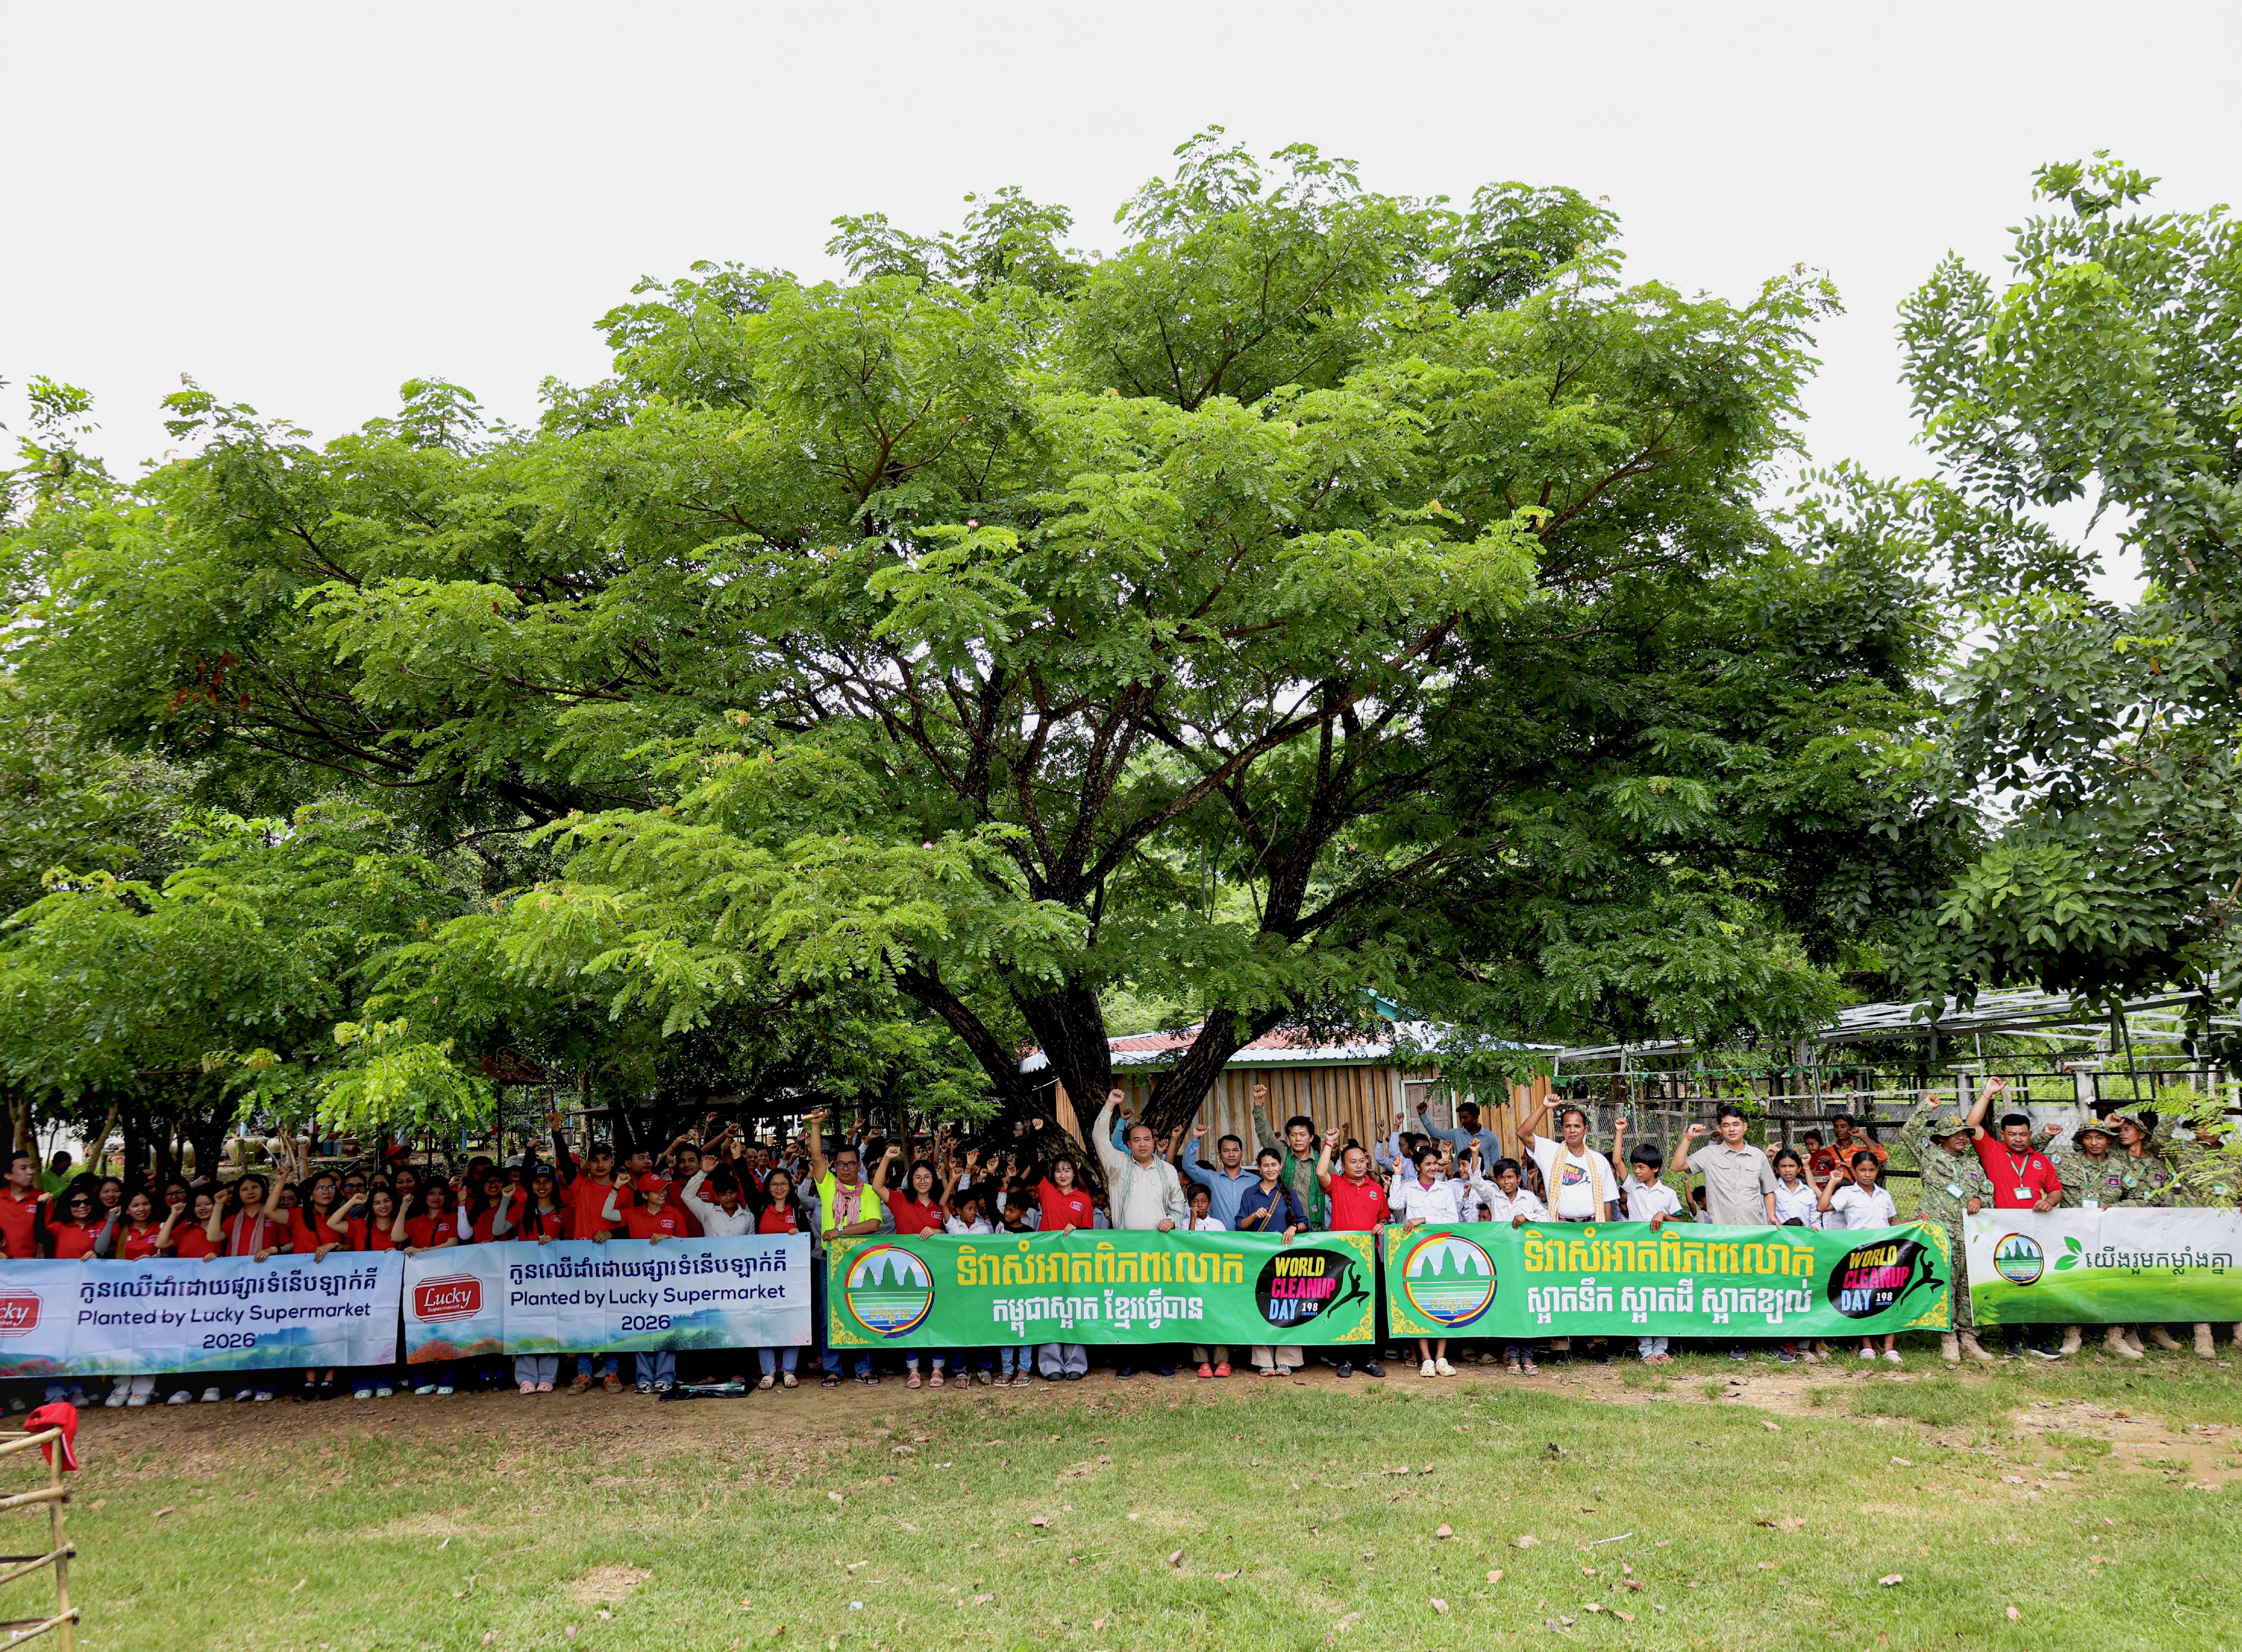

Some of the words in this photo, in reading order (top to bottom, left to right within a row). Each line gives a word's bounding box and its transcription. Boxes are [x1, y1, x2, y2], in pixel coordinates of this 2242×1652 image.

[1563, 1170, 1582, 1180] LEANUP
[1276, 1257, 1324, 1276] WORLD
[1850, 1246, 1896, 1268] WORLD
[1271, 1278, 1336, 1298] CLEANUP
[1844, 1267, 1909, 1288] CLEANUP
[423, 1286, 472, 1309] Lucky
[511, 1290, 579, 1306] Planted
[585, 1290, 605, 1307] by
[610, 1289, 658, 1307] Lucky
[664, 1284, 785, 1305] Supermarket
[1840, 1289, 1871, 1311] DAY
[1876, 1292, 1892, 1301] 198
[0, 1302, 30, 1326] cky
[78, 1310, 156, 1325] Planted
[162, 1310, 186, 1326] by
[191, 1307, 244, 1325] Lucky
[250, 1303, 370, 1323] Supermarket
[427, 1304, 460, 1313] Supermarket
[1269, 1299, 1298, 1321] DAY
[1302, 1303, 1317, 1311] 198
[622, 1315, 670, 1330] 2026
[203, 1333, 256, 1349] 2026
